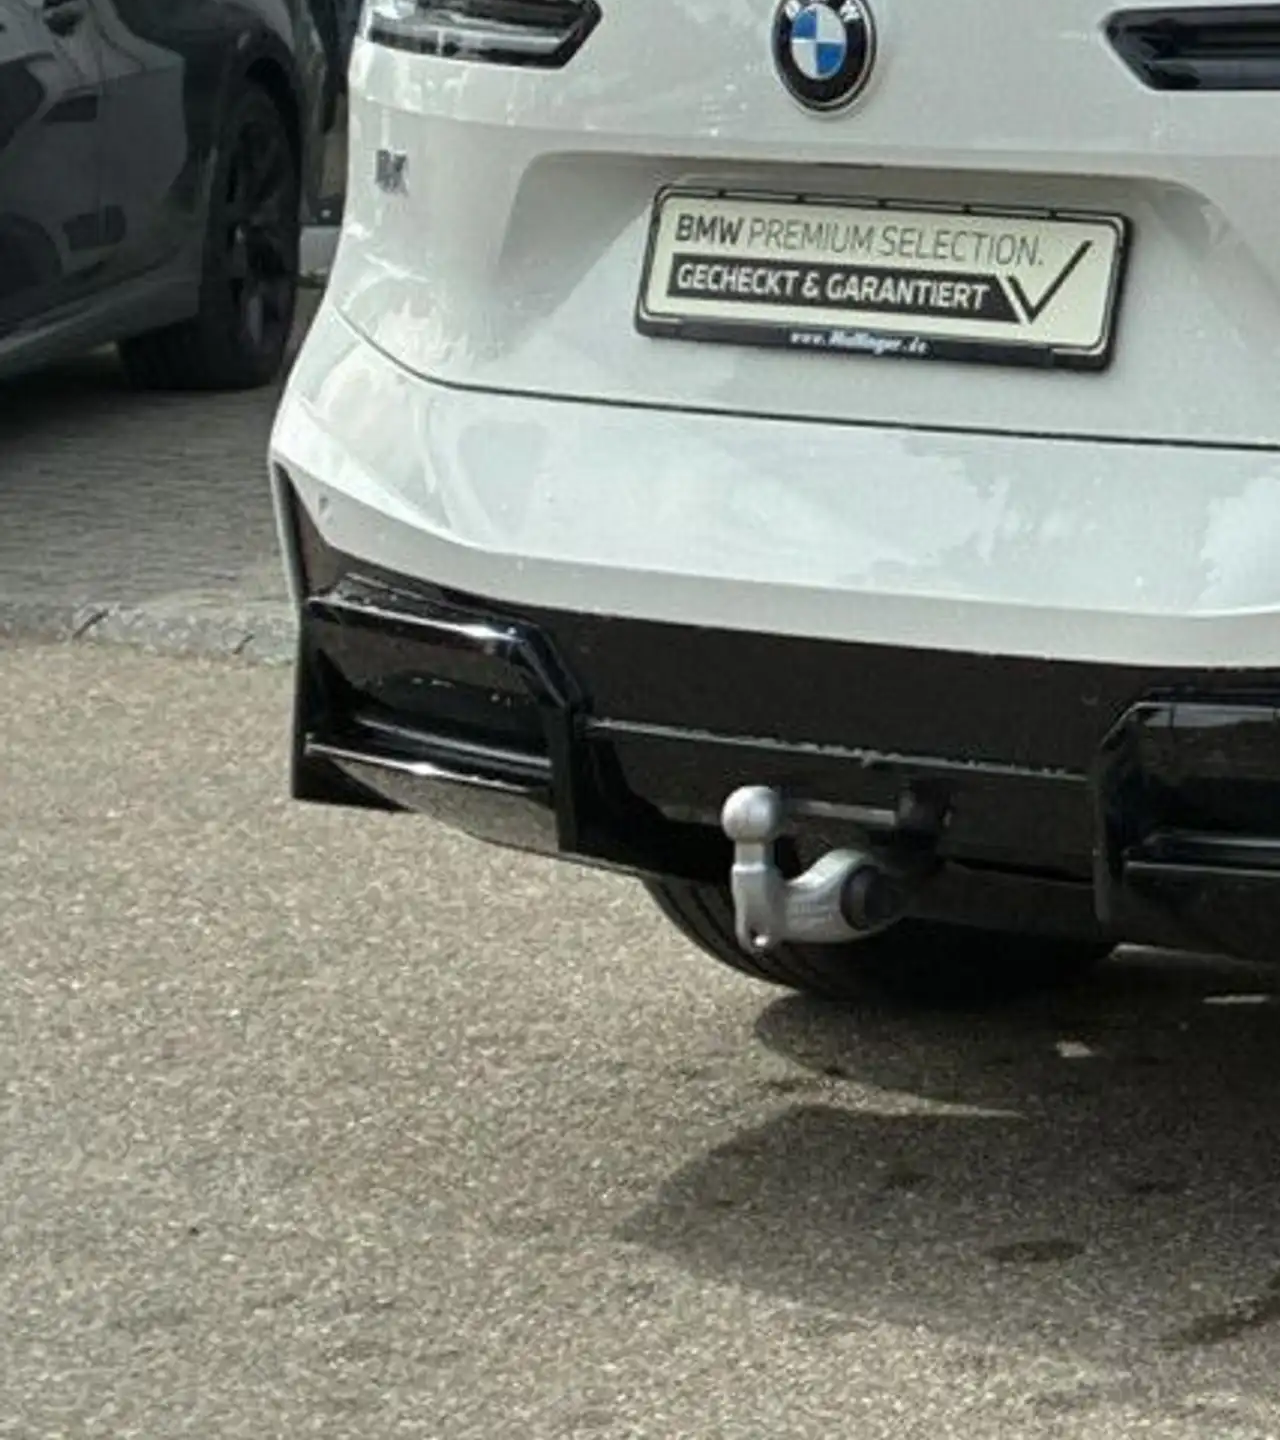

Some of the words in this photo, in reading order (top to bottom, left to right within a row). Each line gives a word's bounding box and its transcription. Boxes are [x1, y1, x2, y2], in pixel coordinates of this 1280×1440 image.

[675, 212, 745, 246] BMW
[748, 216, 878, 254] PREMIUM
[878, 224, 1045, 268] SELECTION.
[676, 262, 800, 297] GECHECKT
[801, 271, 820, 298] &
[825, 273, 991, 310] GARANTIERT
